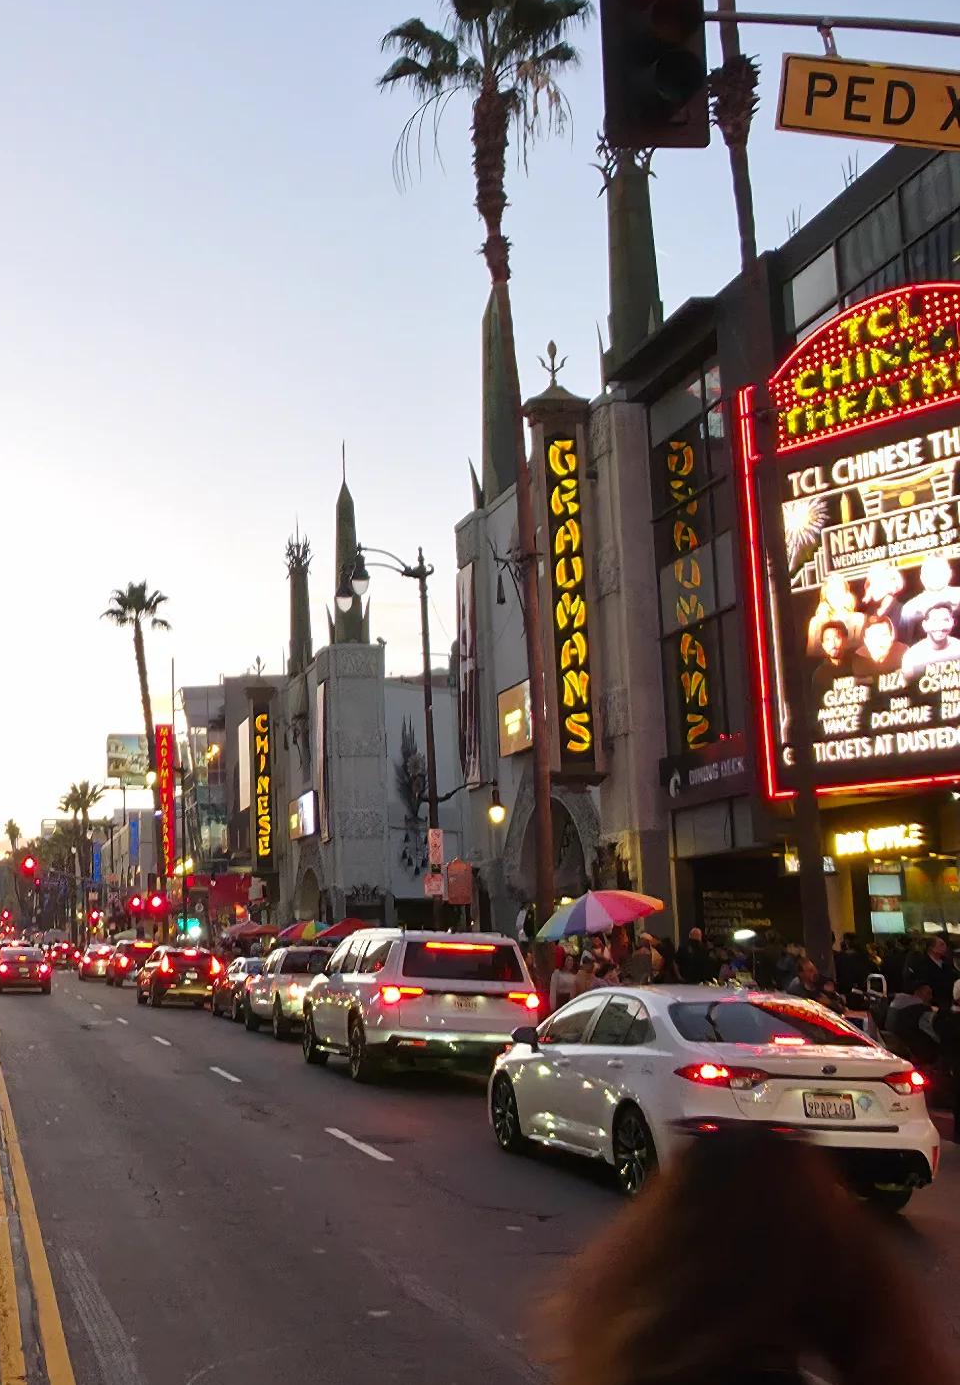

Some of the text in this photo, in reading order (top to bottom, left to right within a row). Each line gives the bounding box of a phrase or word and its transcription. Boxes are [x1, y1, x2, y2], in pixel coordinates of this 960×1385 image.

[805, 71, 916, 126] PED
[840, 300, 920, 345] TCL
[788, 466, 830, 497] TCL
[831, 437, 924, 485] CHINESE
[829, 503, 954, 555] NEW YEAR'S
[832, 544, 888, 569] WEDNESDAY
[888, 533, 939, 557] DECEMBER
[548, 440, 592, 753] GRAUMANS
[812, 736, 872, 763] TICKETS
[874, 733, 894, 756] AT
[255, 713, 271, 856] CHINESE
